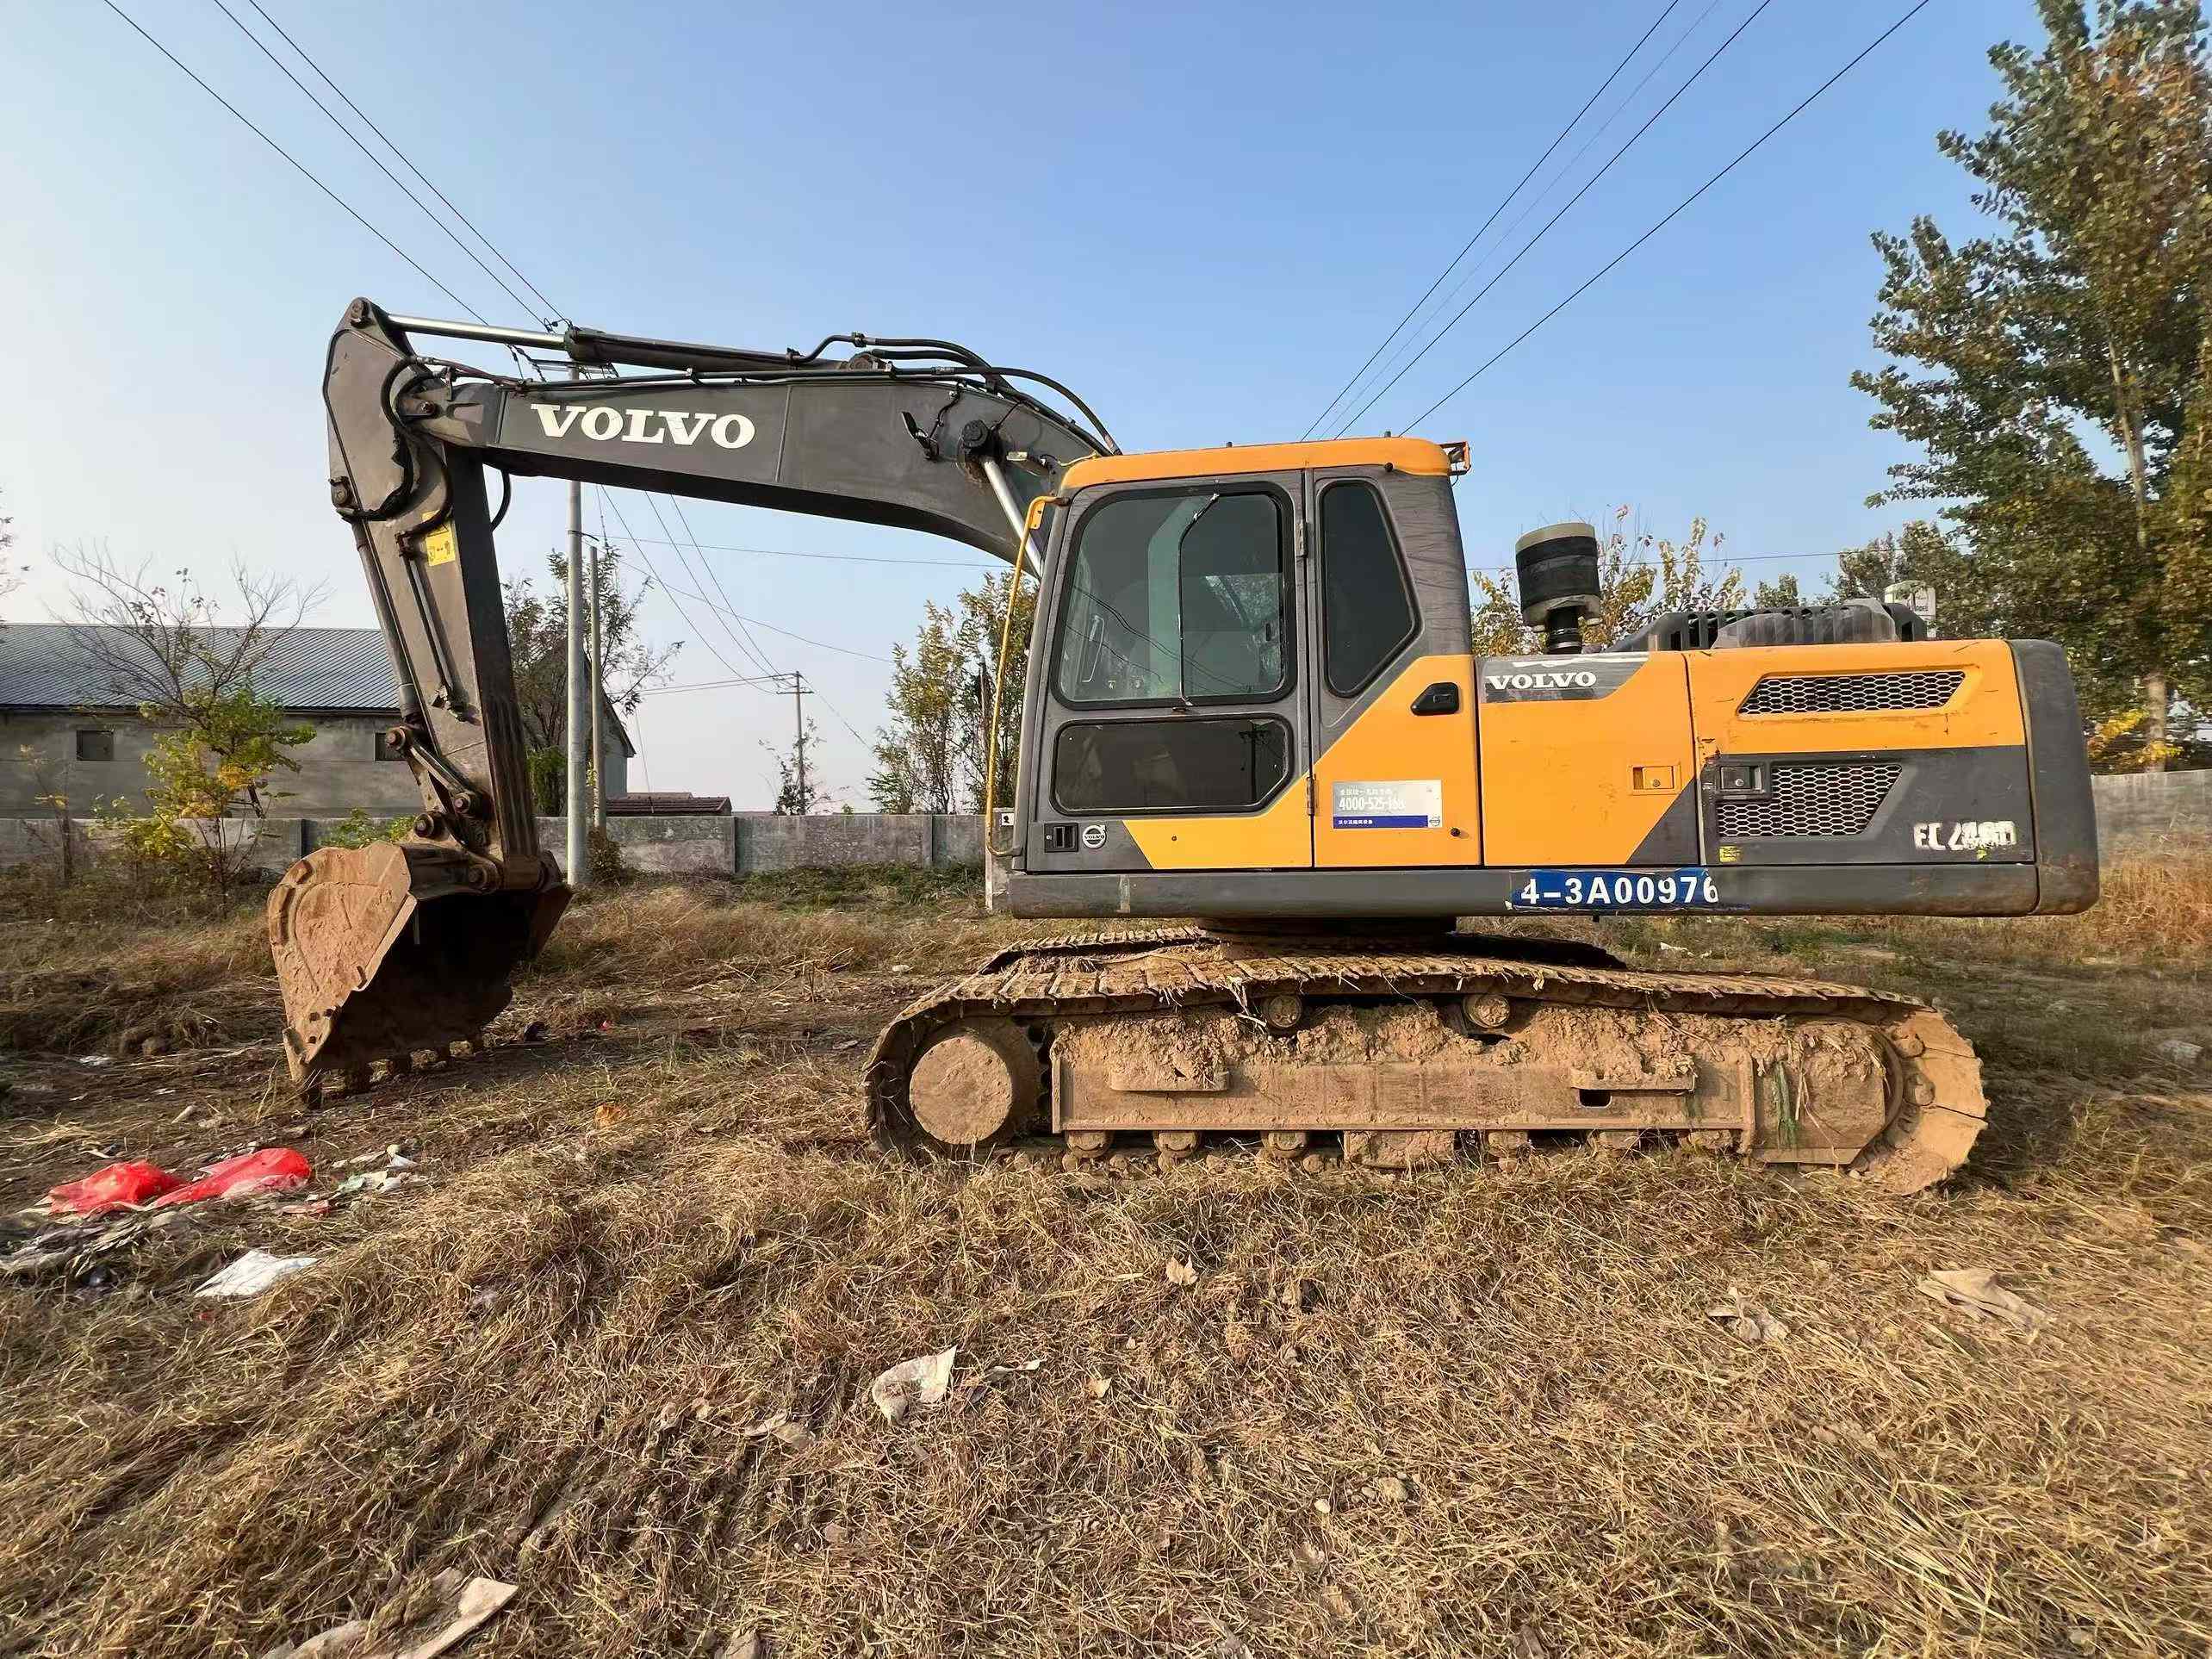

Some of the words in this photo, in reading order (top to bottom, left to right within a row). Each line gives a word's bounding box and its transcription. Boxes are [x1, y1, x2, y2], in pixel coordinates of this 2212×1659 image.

[531, 403, 755, 450] VOLVO
[1486, 671, 1597, 690] VOLVO
[1520, 876, 1719, 905] 4-3A00976
